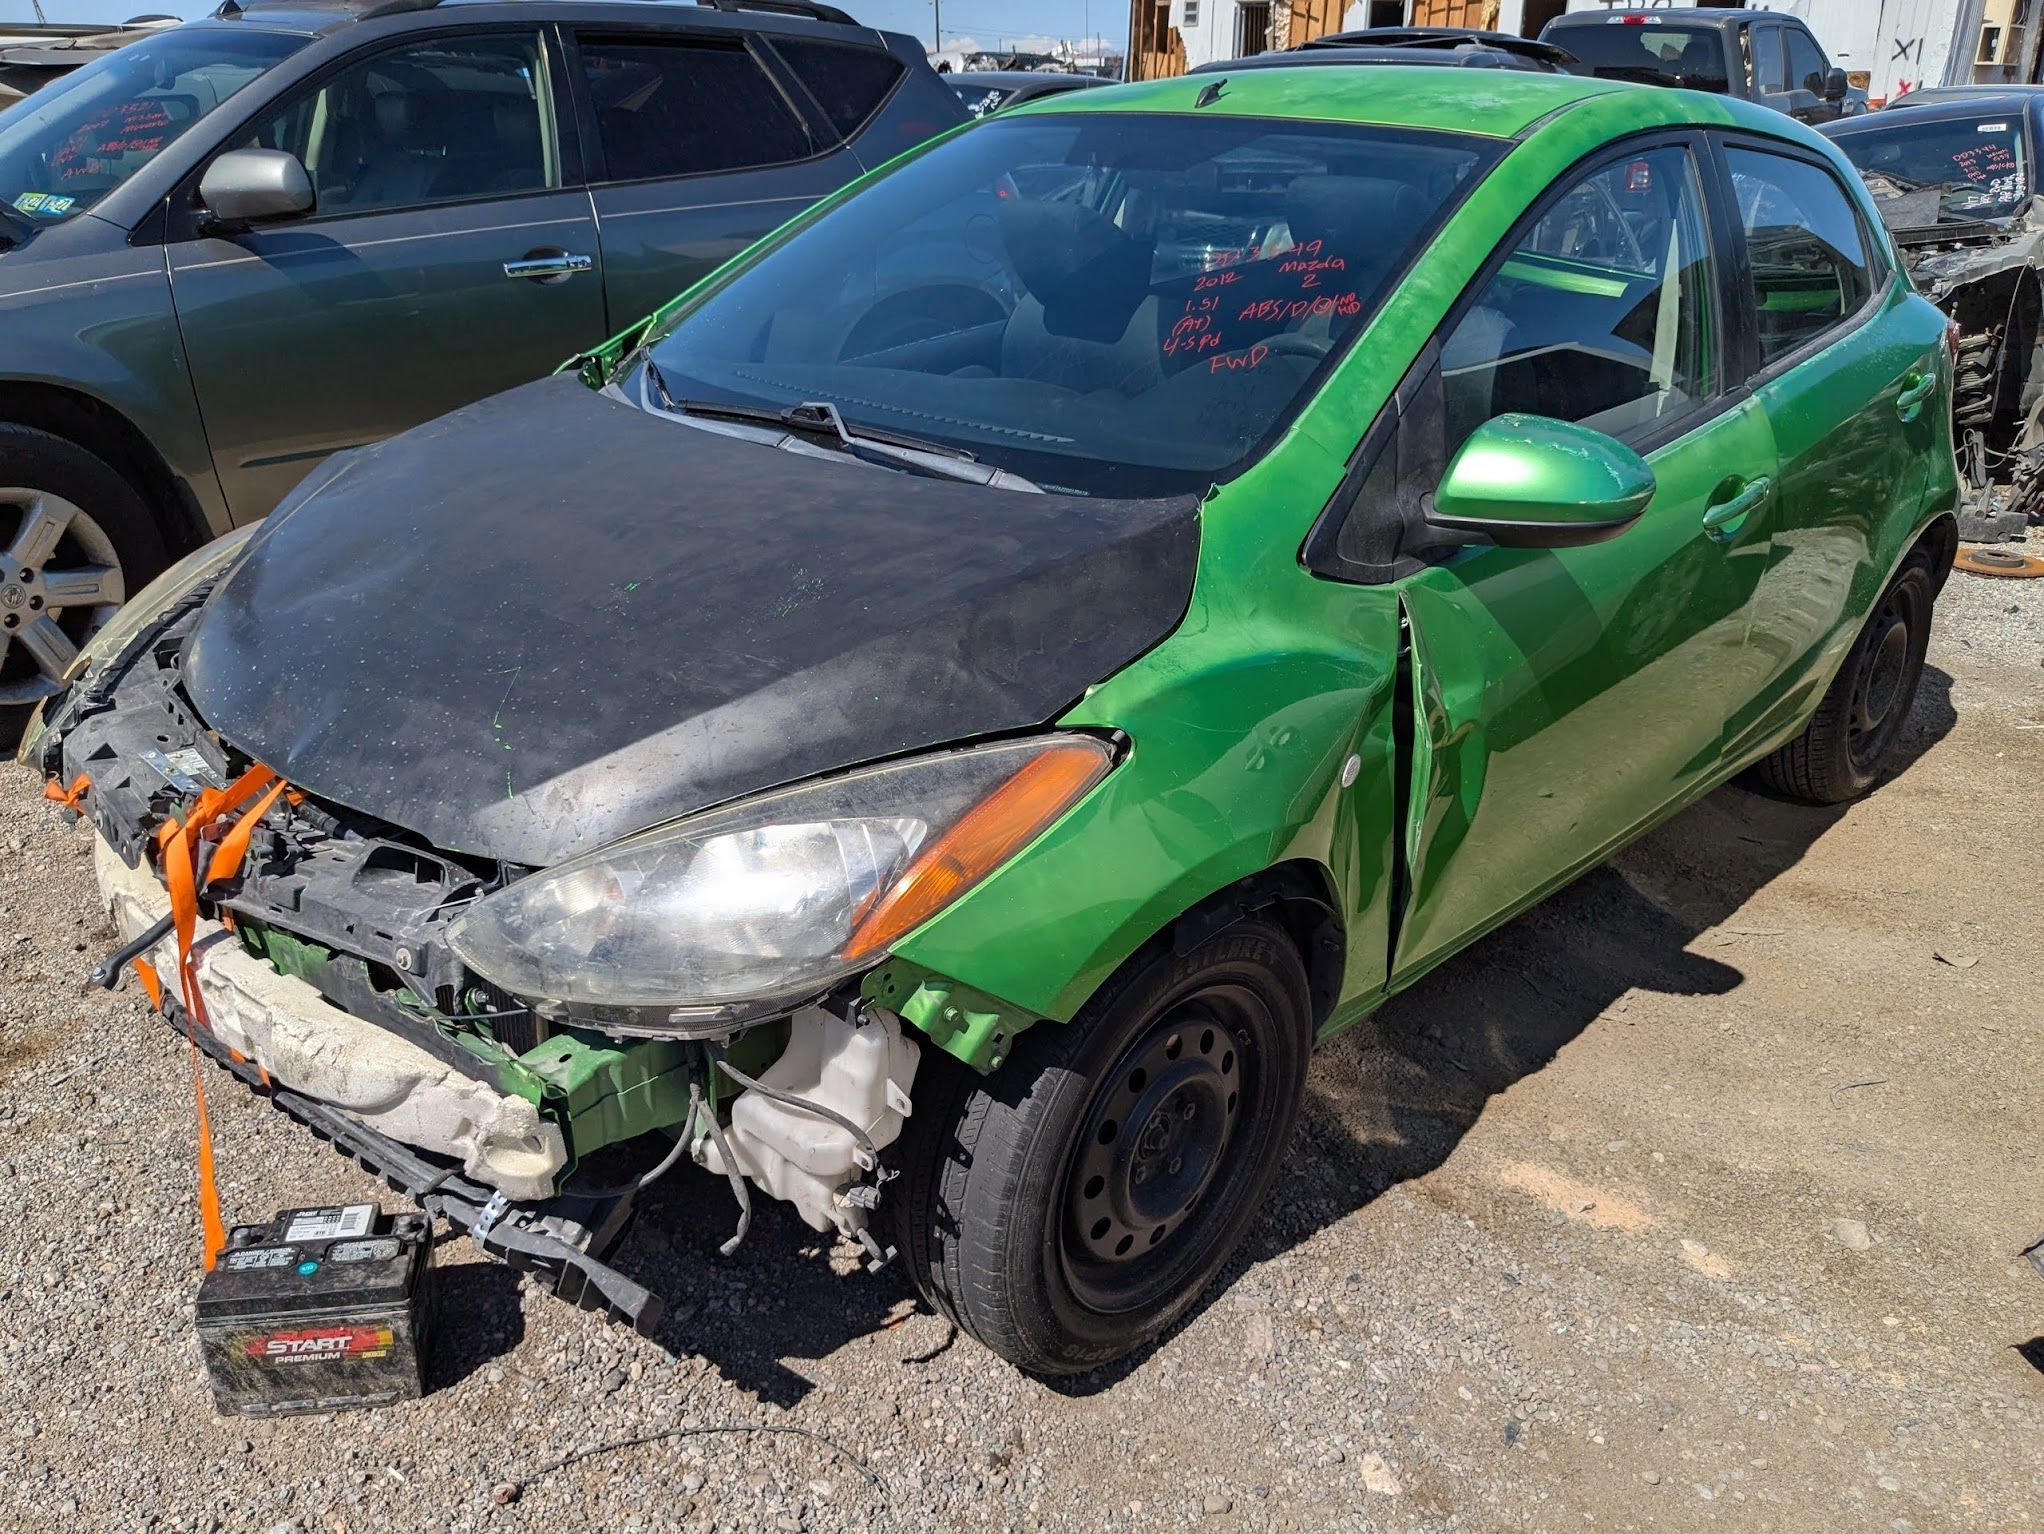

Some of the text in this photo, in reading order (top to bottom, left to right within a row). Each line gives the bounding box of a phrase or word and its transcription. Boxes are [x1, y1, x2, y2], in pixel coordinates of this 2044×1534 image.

[1194, 271, 1244, 292] 2012
[1302, 274, 1321, 288] 2
[1211, 346, 1268, 374] FWD
[266, 1335, 353, 1355] START
[275, 1351, 341, 1364] PREMIUM
